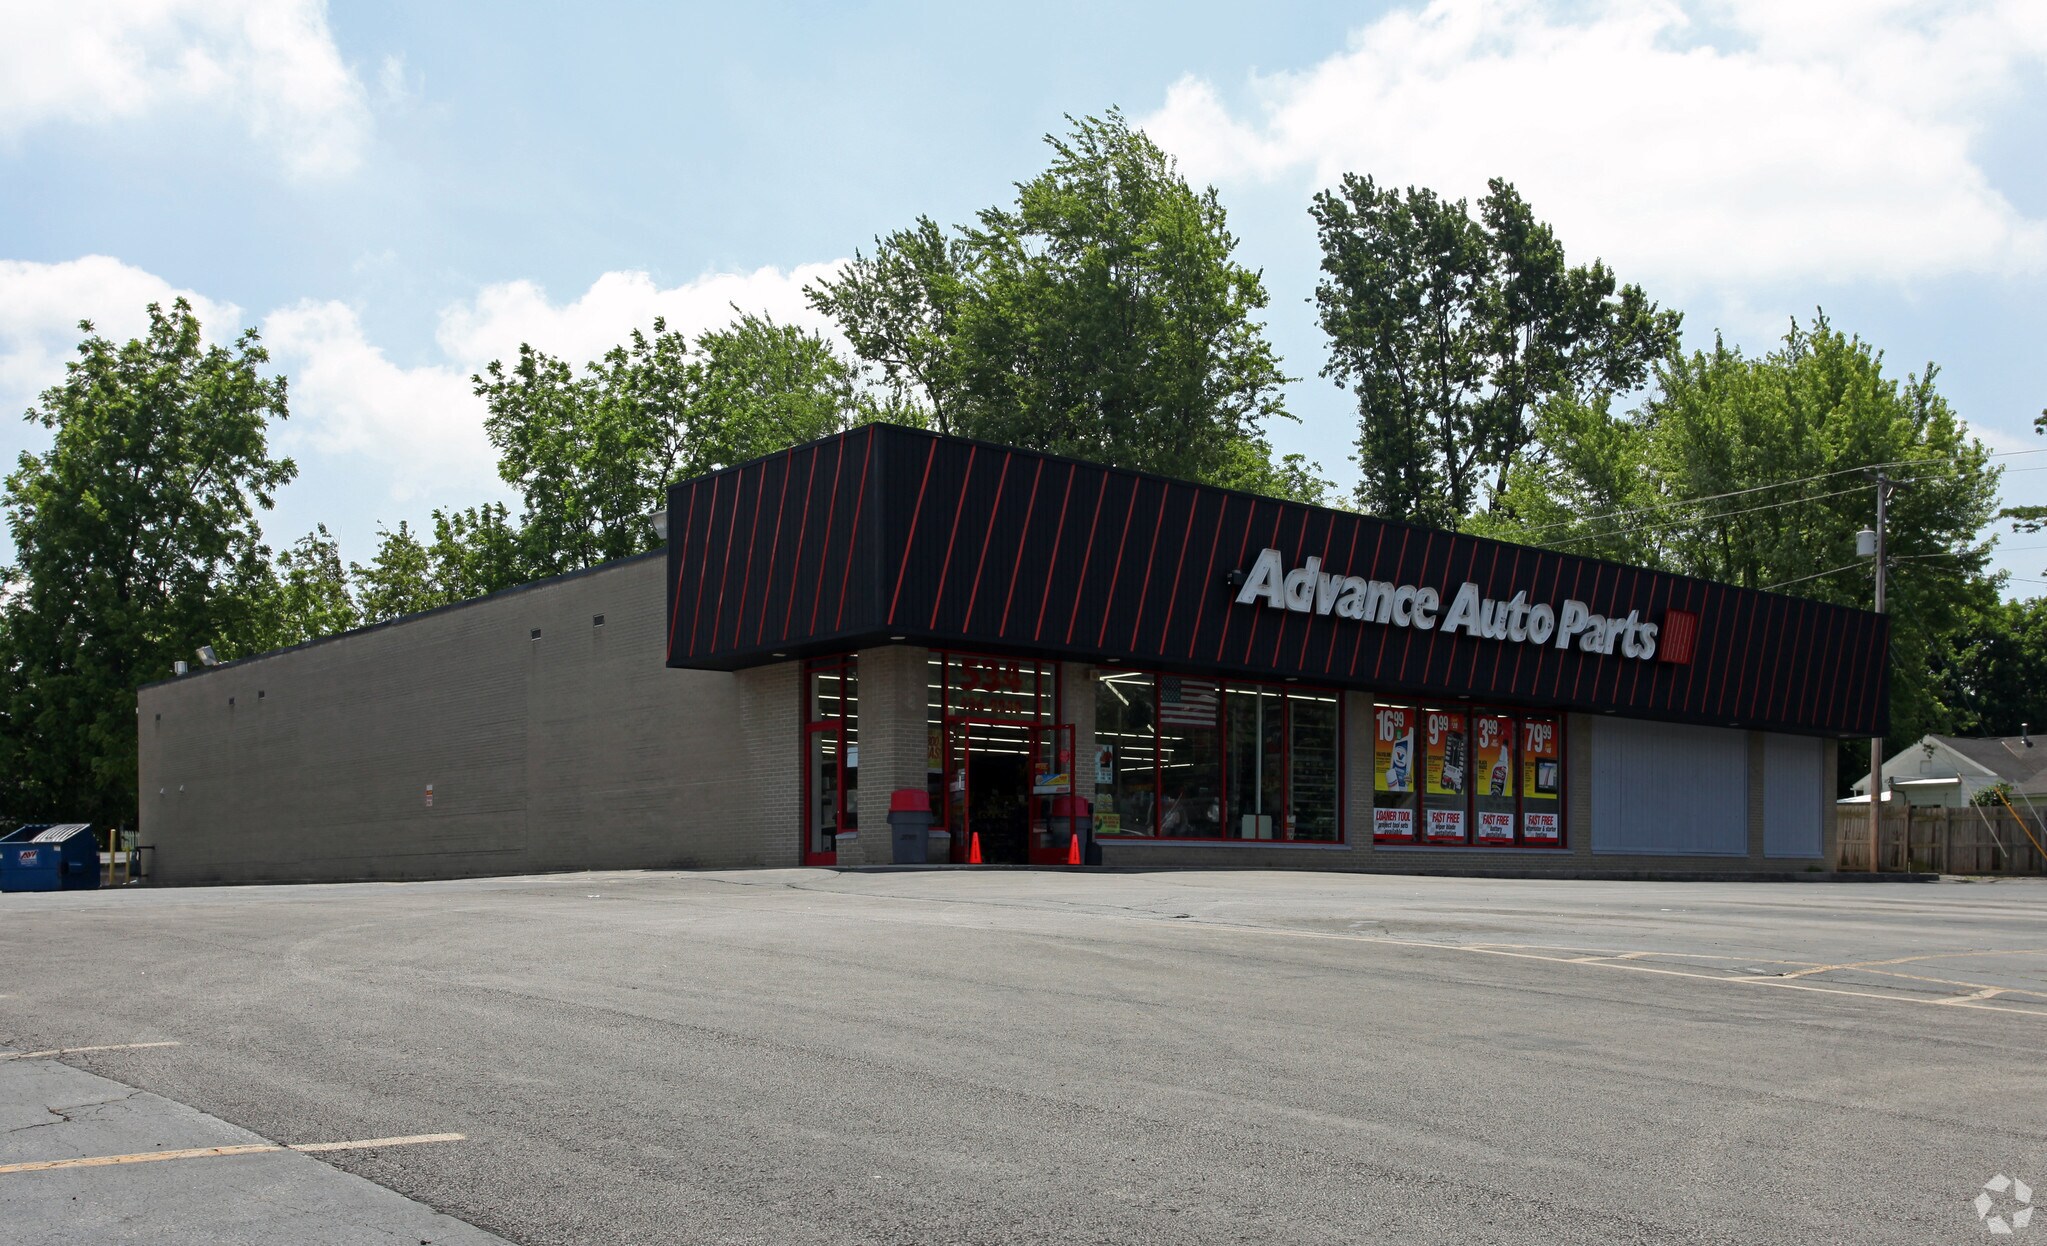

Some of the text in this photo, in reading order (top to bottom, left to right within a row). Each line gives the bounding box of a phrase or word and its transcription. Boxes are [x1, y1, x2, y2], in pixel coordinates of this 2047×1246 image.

[1236, 547, 1659, 660] Advance Auto Parts
[1376, 810, 1411, 822] LOANER TOOL
[1432, 812, 1460, 823] FAST FREE
[1483, 814, 1510, 826] FAST FREE
[1528, 815, 1554, 826] FAST FREE
